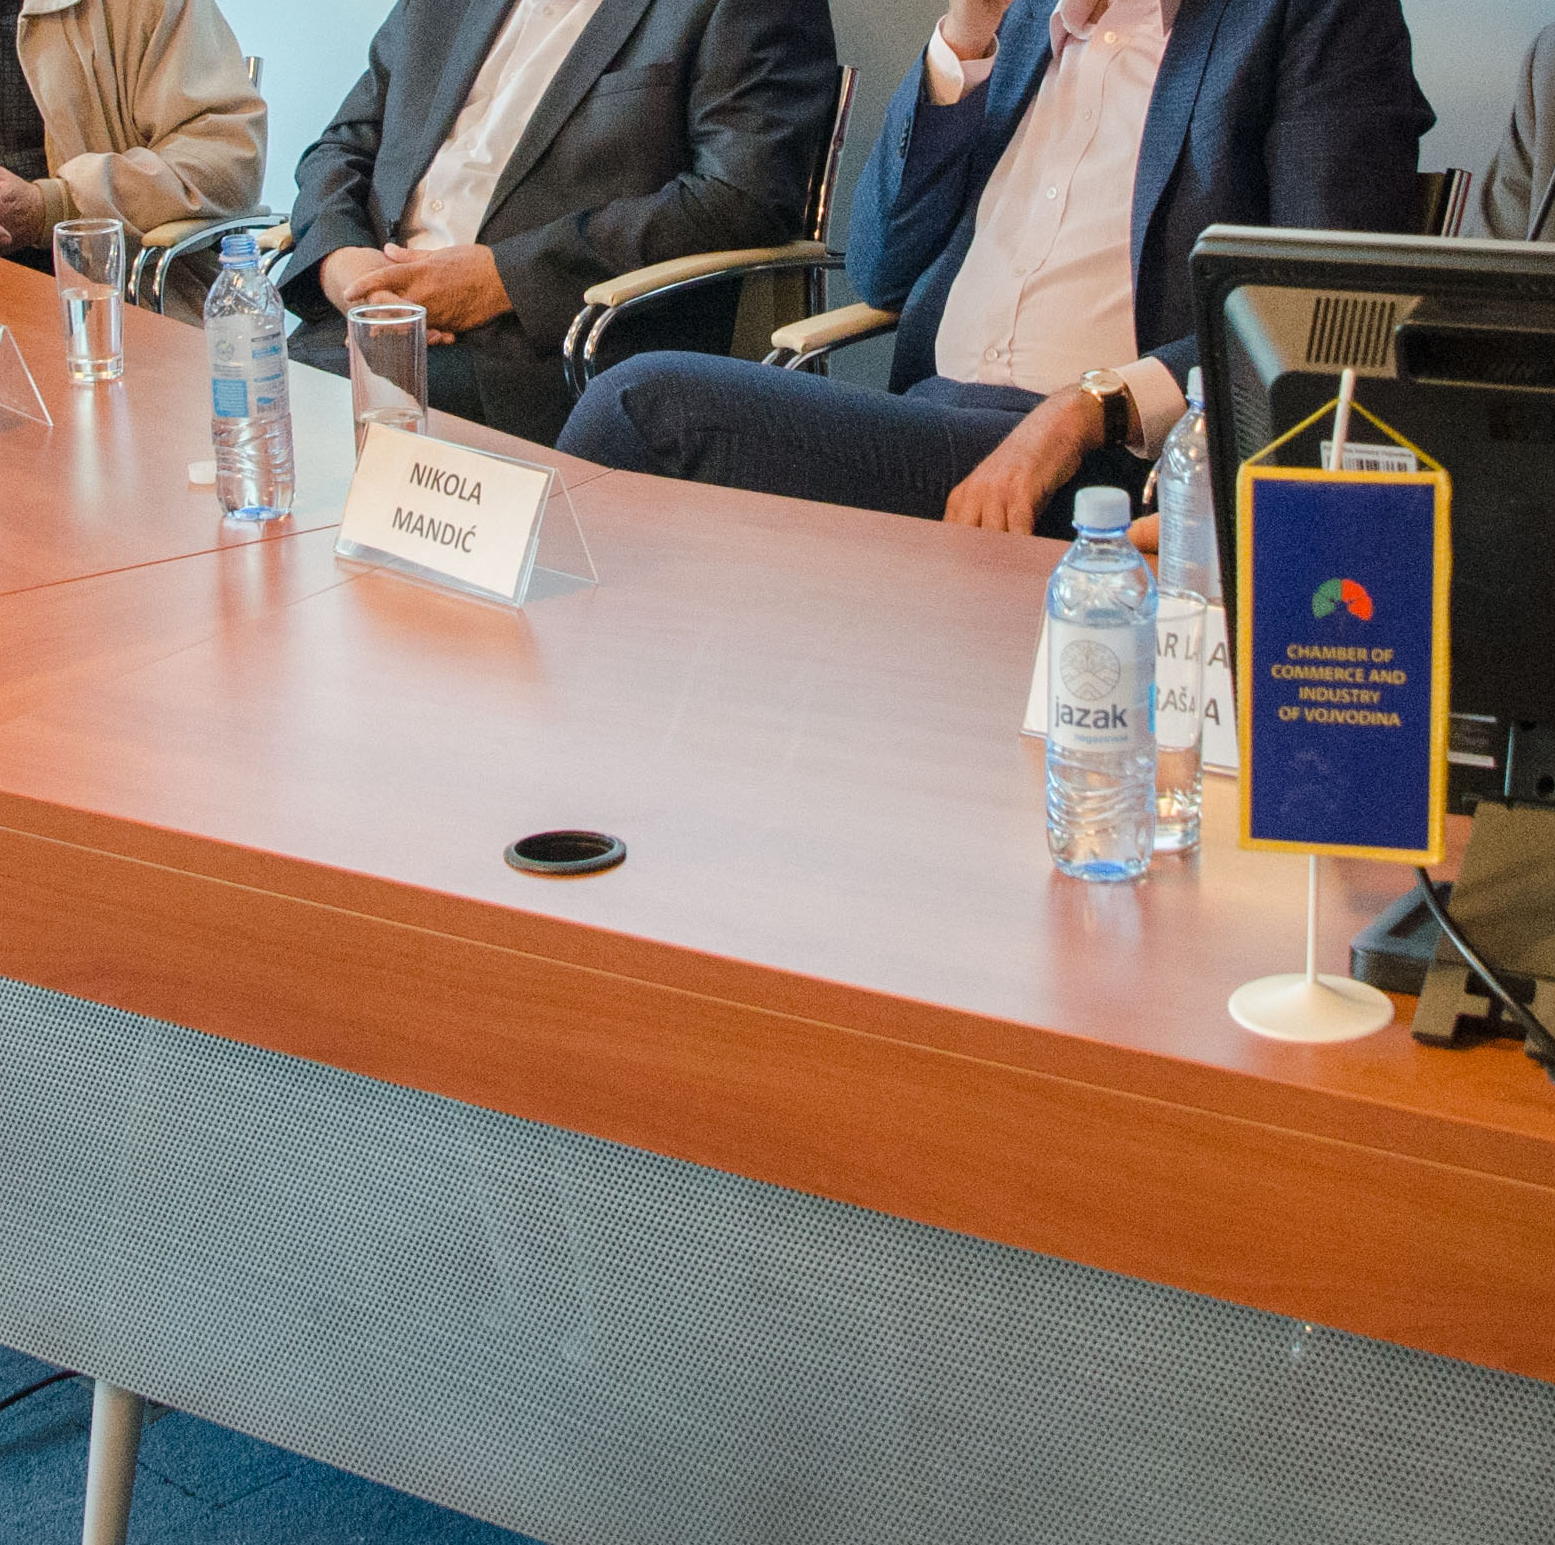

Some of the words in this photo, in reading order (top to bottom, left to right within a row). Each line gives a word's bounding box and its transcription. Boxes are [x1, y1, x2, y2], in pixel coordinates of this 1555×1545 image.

[409, 462, 482, 505] NIKOLA
[392, 506, 477, 553] MANDIĆ
[1286, 643, 1368, 662] CHAMBER
[1371, 647, 1394, 663] OF
[1270, 664, 1365, 683] COMMERCE
[1369, 669, 1408, 685] AND
[1298, 686, 1382, 704] INDUSTRY
[1055, 696, 1128, 729] jazak
[1278, 705, 1300, 721] OF
[1303, 707, 1402, 727] VOJVODINA
